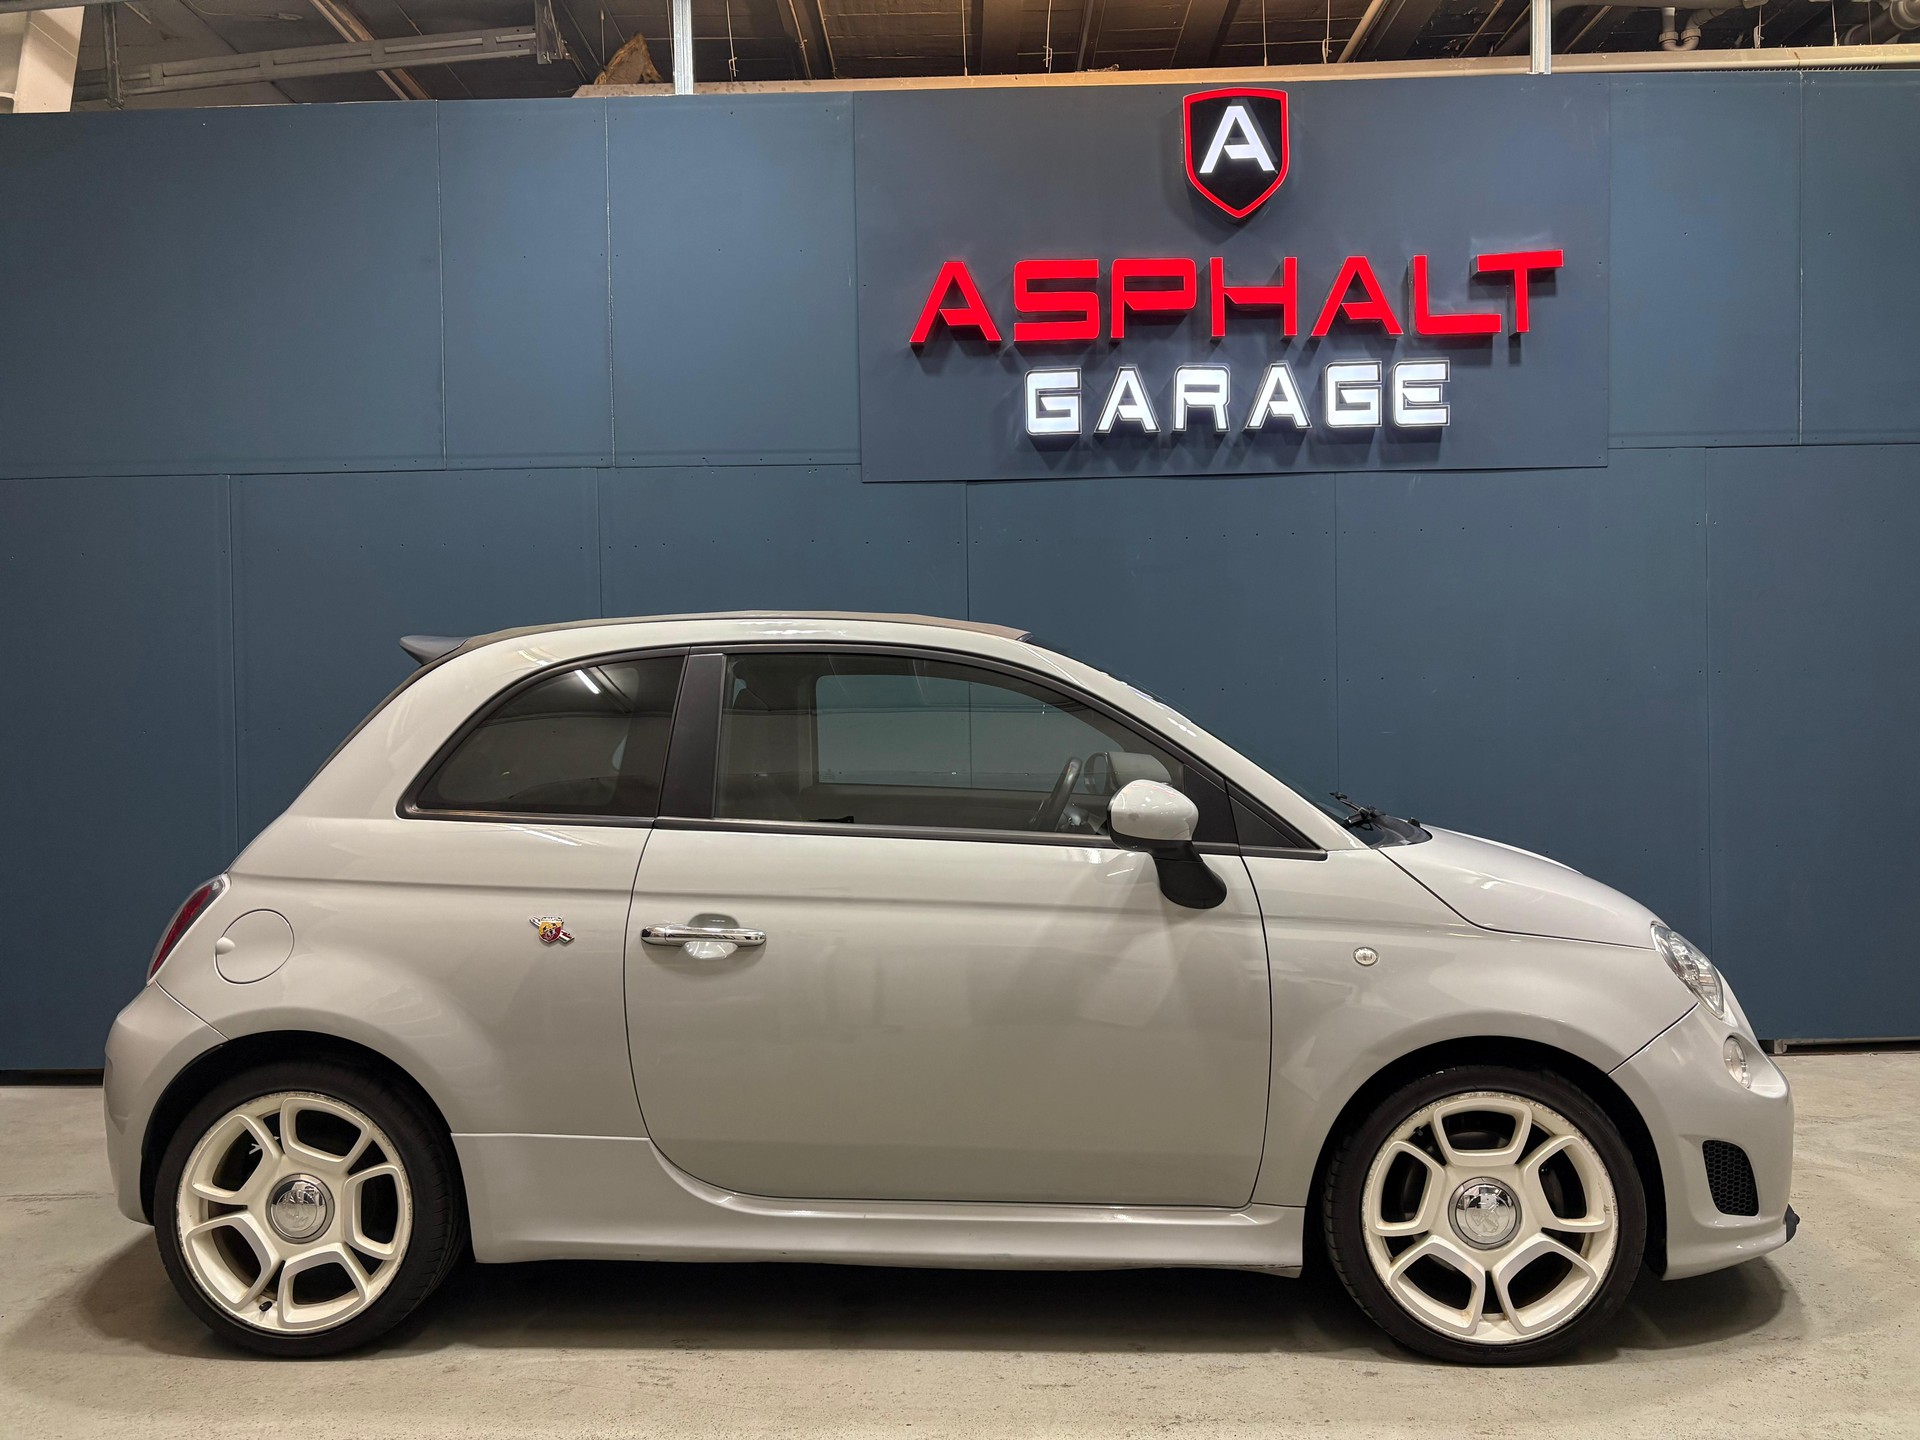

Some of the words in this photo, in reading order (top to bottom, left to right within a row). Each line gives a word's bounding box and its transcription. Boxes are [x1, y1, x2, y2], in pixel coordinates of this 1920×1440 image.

[1199, 105, 1276, 174] A
[909, 249, 1563, 343] ASPHALT
[1025, 359, 1451, 435] GARAGE
